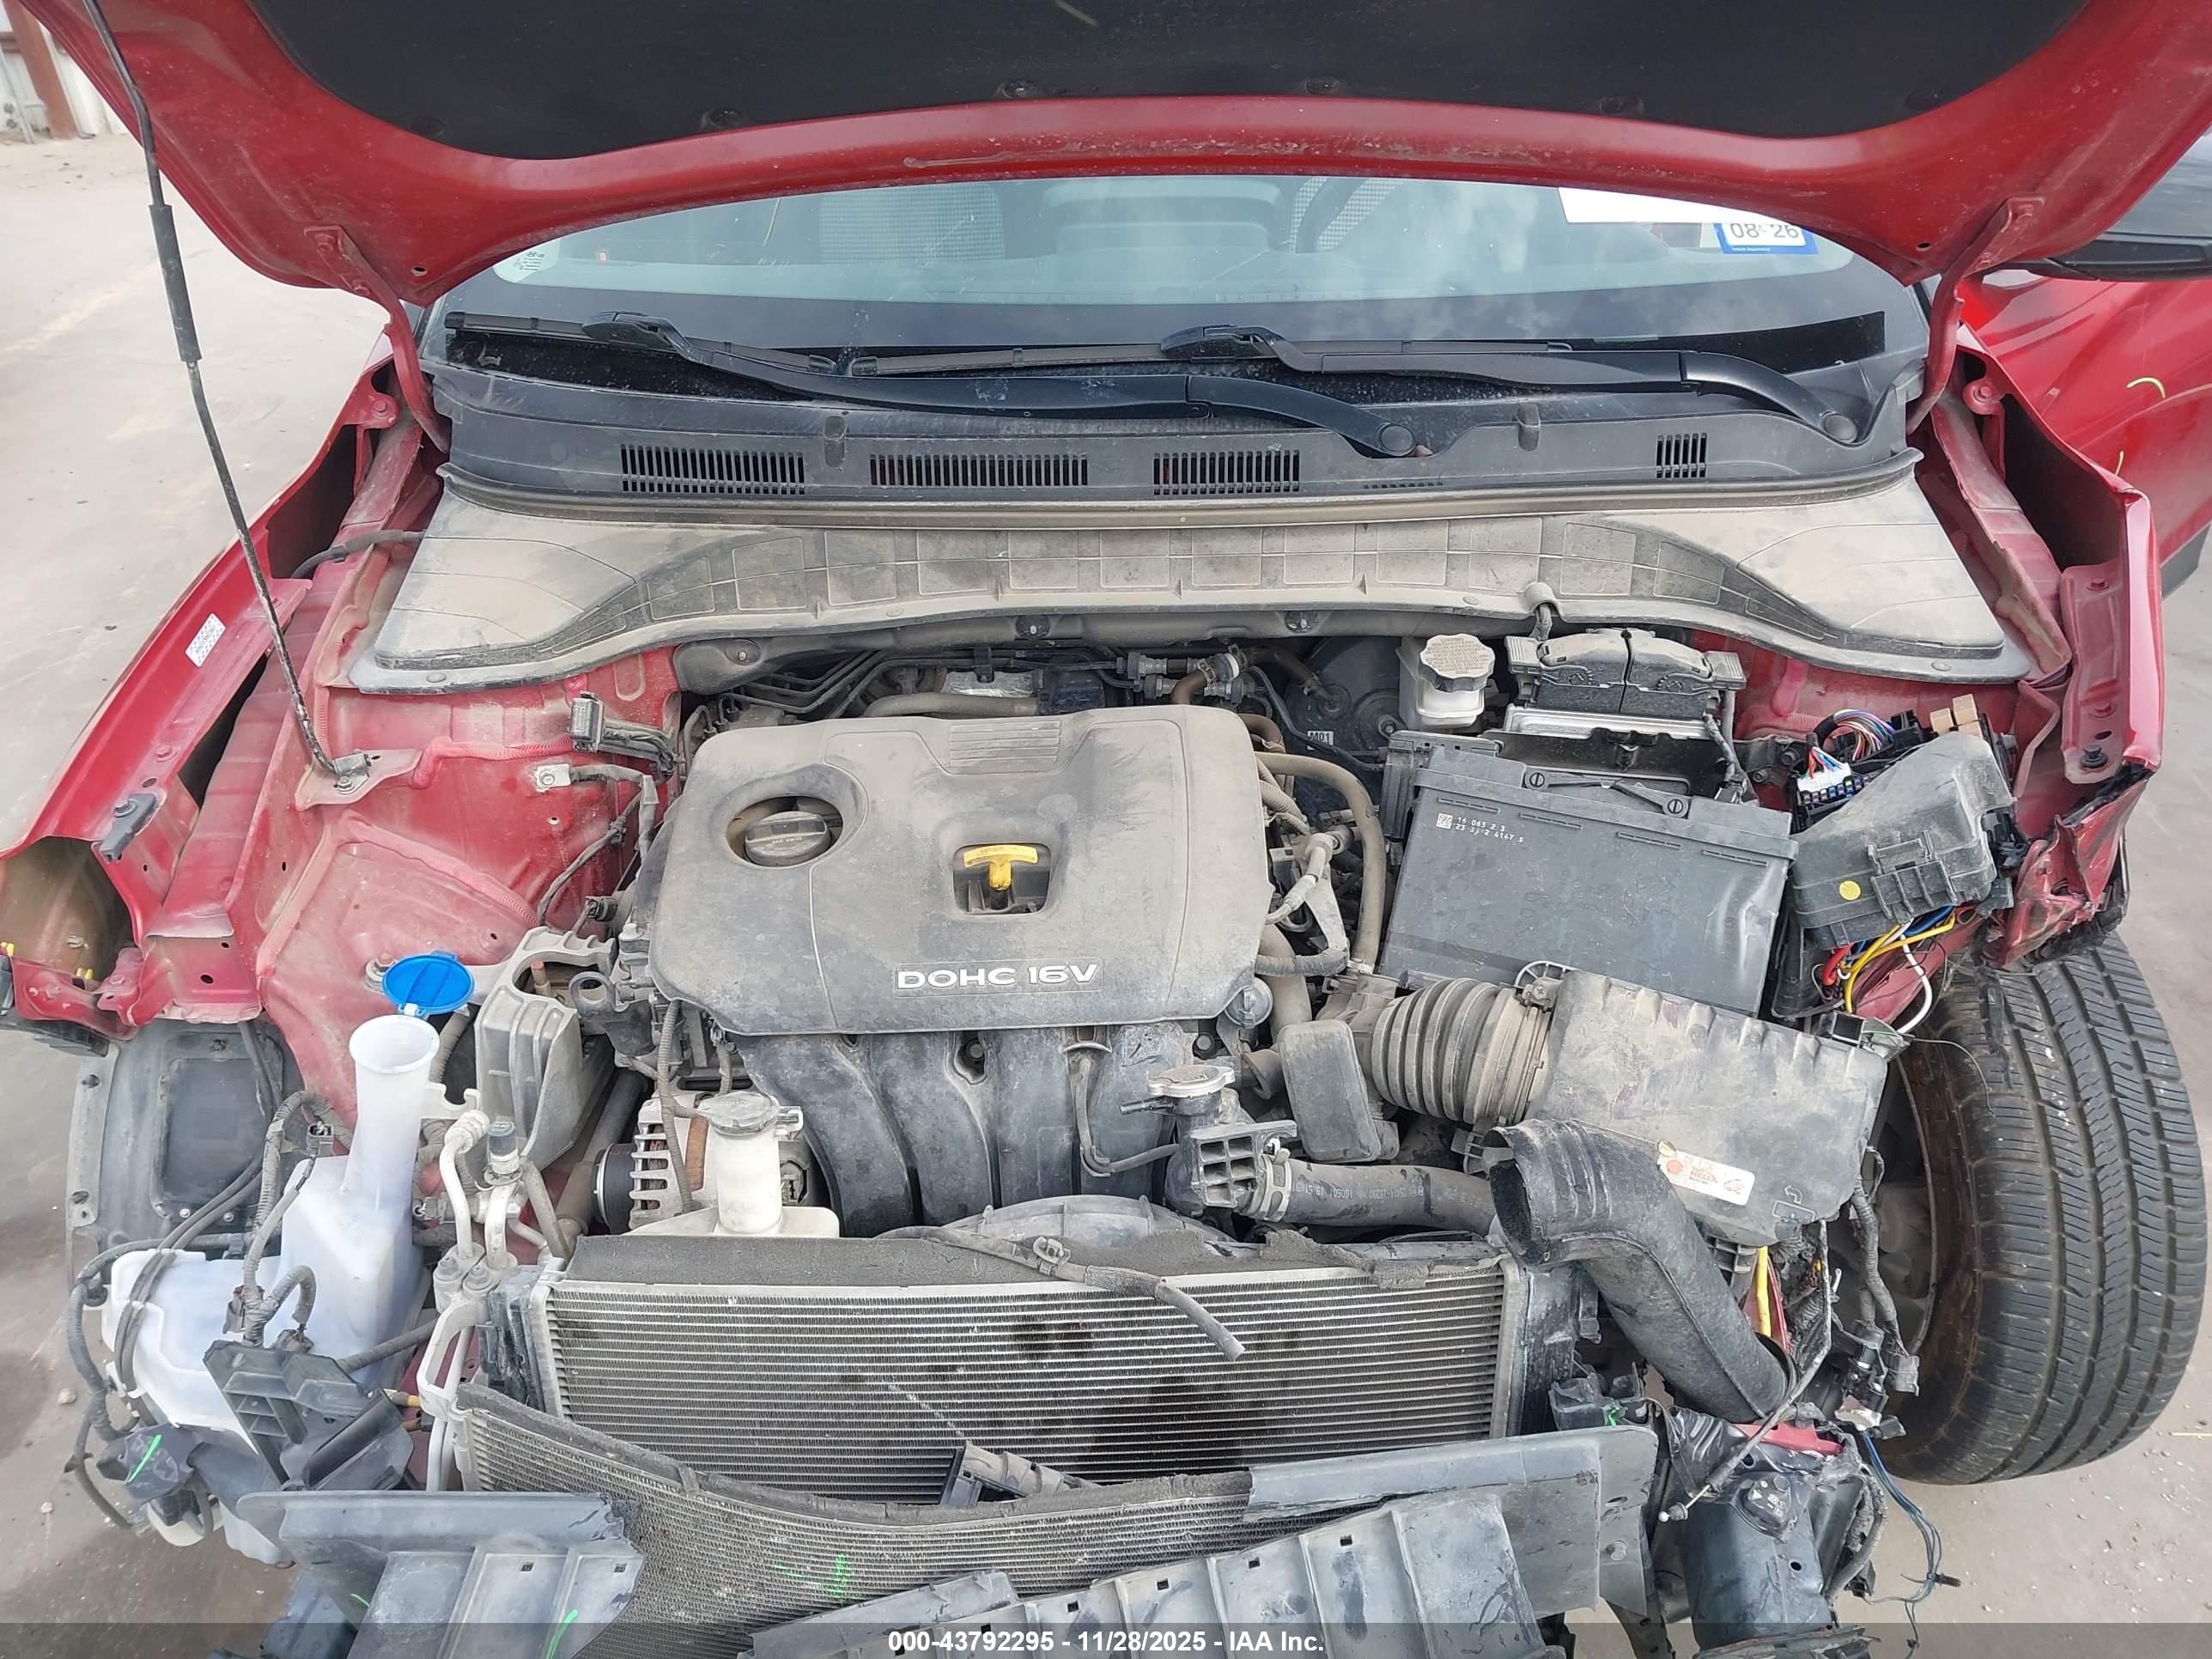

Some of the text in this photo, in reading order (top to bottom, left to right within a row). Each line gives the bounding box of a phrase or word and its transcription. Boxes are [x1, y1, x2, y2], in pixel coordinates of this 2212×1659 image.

[1729, 222, 1799, 239] 08 26
[896, 963, 1099, 990] DOHC 16V
